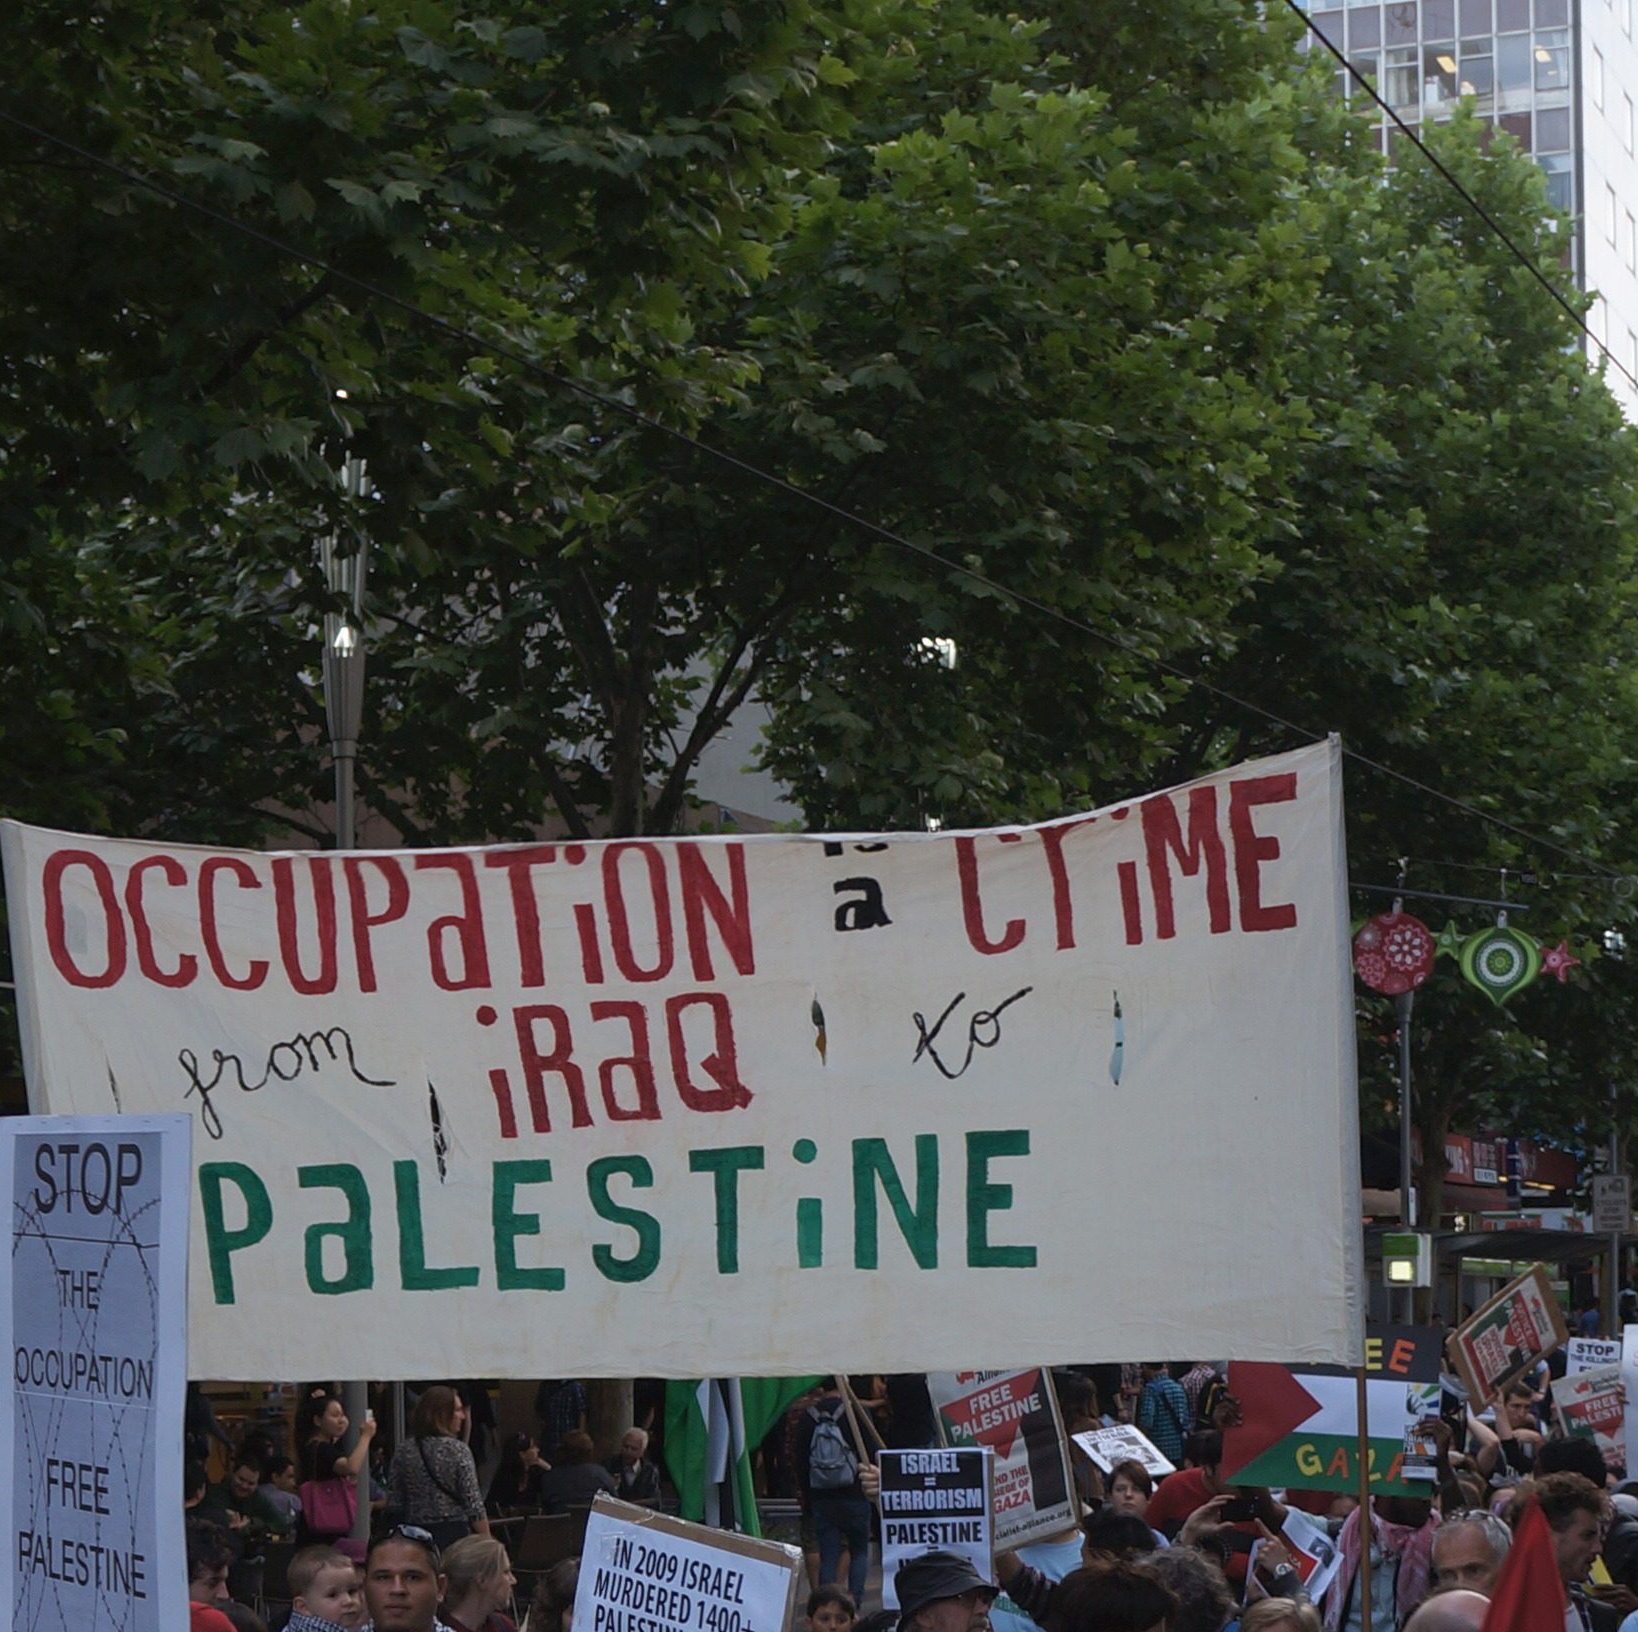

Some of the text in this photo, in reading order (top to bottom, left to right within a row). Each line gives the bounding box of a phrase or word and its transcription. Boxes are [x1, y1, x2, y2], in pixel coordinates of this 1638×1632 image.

[178, 1025, 396, 1137] from
[915, 988, 1031, 1079] to
[34, 1142, 143, 1216] STOP
[59, 1269, 99, 1311] THE
[15, 1346, 153, 1399] OCCUPATION
[1576, 1343, 1614, 1356] STOP
[951, 1393, 1042, 1443] PALESTINE
[969, 1384, 1013, 1415] FREE
[900, 1454, 960, 1474] ISRAEL
[1013, 1465, 1028, 1479] THE
[46, 1459, 111, 1516] FREE
[881, 1488, 983, 1511] TERRORISM
[994, 1491, 1031, 1514] GAZA
[886, 1522, 982, 1545] PALESTINE
[19, 1531, 146, 1600] PALESTINE
[613, 1538, 744, 1604] IN 2009 ISRAEL
[594, 1568, 691, 1624] MURDERED
